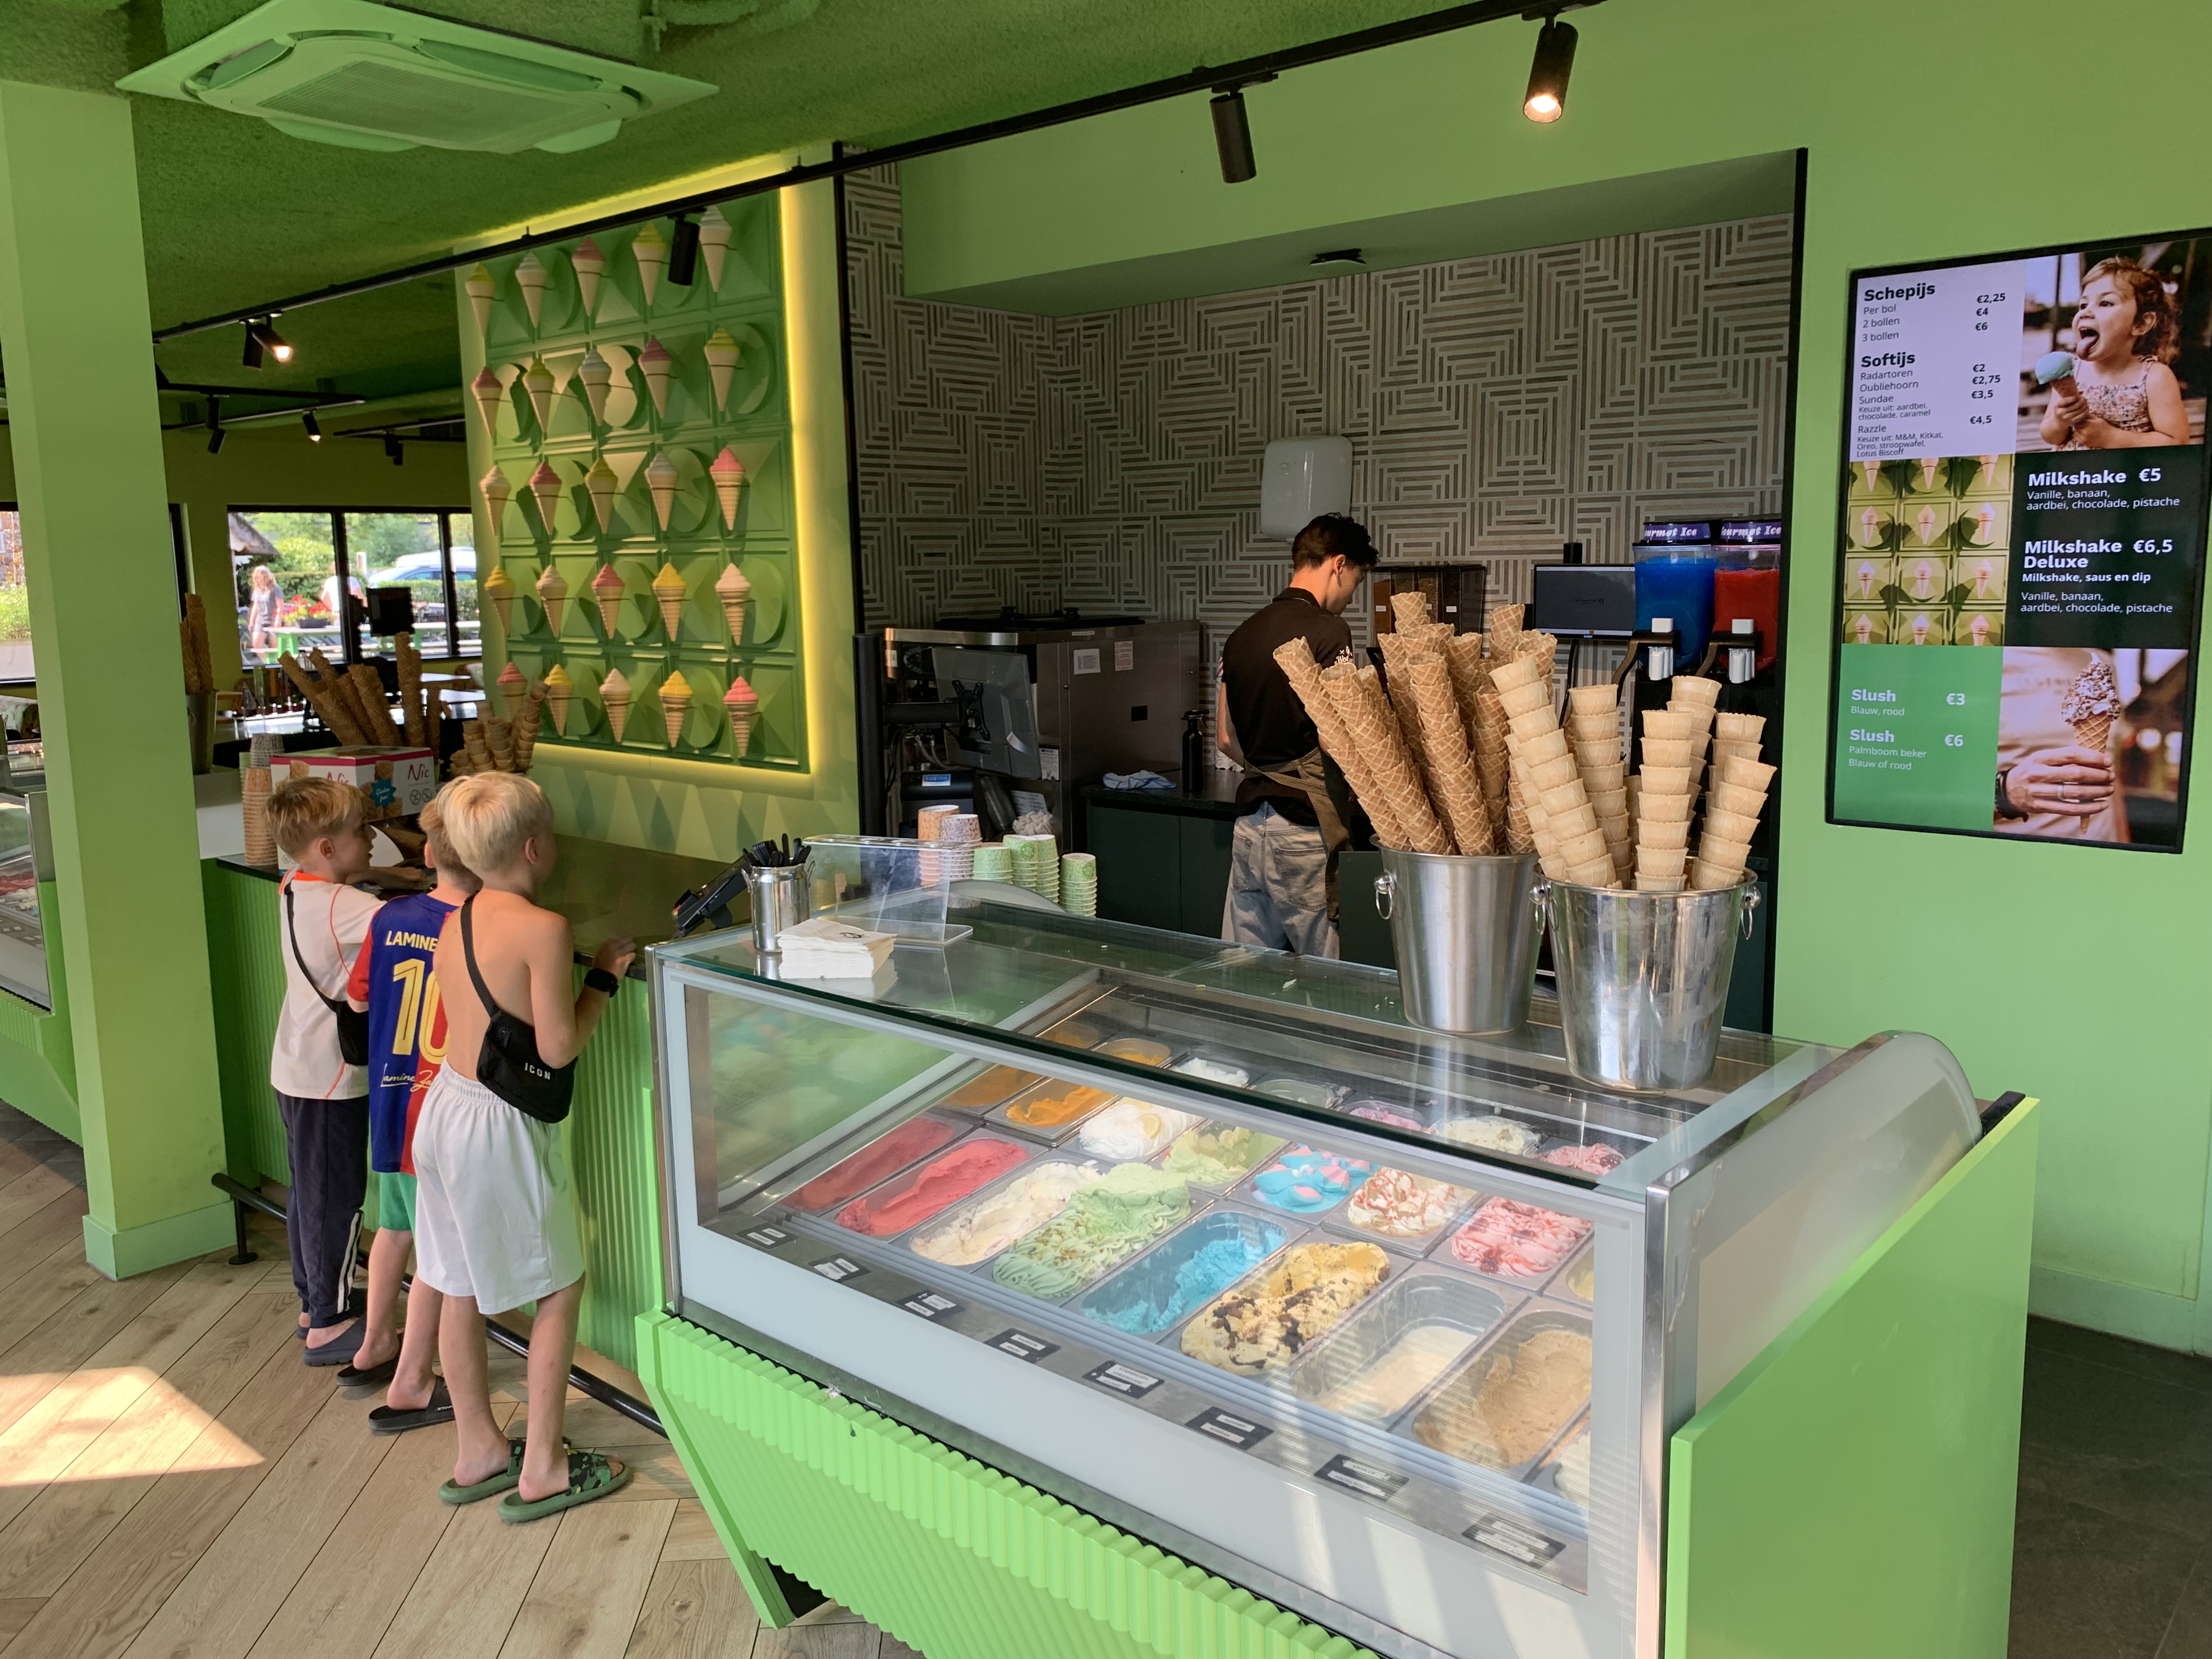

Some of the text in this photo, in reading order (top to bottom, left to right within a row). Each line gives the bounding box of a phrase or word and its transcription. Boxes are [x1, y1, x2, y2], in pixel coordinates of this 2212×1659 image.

[1864, 283, 1936, 301] Schepijs
[1977, 293, 2006, 304] €2,25
[1864, 304, 1897, 315] Per bol
[1976, 308, 1988, 316] €4
[1871, 317, 1900, 327] bollen
[1976, 323, 1987, 331] €6
[1870, 331, 1899, 341] bollen
[1861, 352, 1915, 368] Softijs
[1973, 364, 1985, 373] €2
[1861, 370, 1913, 380] Radartoren
[1972, 375, 2000, 385] €2,75
[1860, 381, 1918, 392] Oubliehoorn
[1859, 395, 1894, 404] Sundae
[1972, 390, 1993, 400] €3,5
[1900, 409, 1931, 417] caramel
[1970, 415, 1992, 425] €4,5
[1858, 425, 1886, 433] Razzle
[2029, 468, 2161, 486] Milkshake €5
[2027, 489, 2110, 500] Vanille, banaan,
[2027, 497, 2180, 510] aardbei, chocolade, pistache
[1680, 527, 1697, 537] Ice
[1764, 525, 1782, 535] Ice
[2025, 539, 2172, 555] Milkshake €6,5
[2024, 556, 2088, 568] Deluxe
[2022, 573, 2083, 583] Milkshake,
[2132, 572, 2151, 583] dip
[2021, 592, 2103, 601] Vanille, banaan,
[2021, 603, 2172, 614] aardbei, chocolade, pistache
[1852, 689, 1966, 706] Slush €3
[1851, 706, 1904, 716] Blauw, rood
[1850, 729, 1963, 747] Slush €6
[1849, 746, 1927, 758] Palmboom beker
[1849, 758, 1911, 770] Blauw of rood
[386, 930, 438, 952] LAMINE
[392, 958, 450, 1064] 10
[380, 1063, 415, 1087] Lamine
[524, 1062, 550, 1080] ICON
